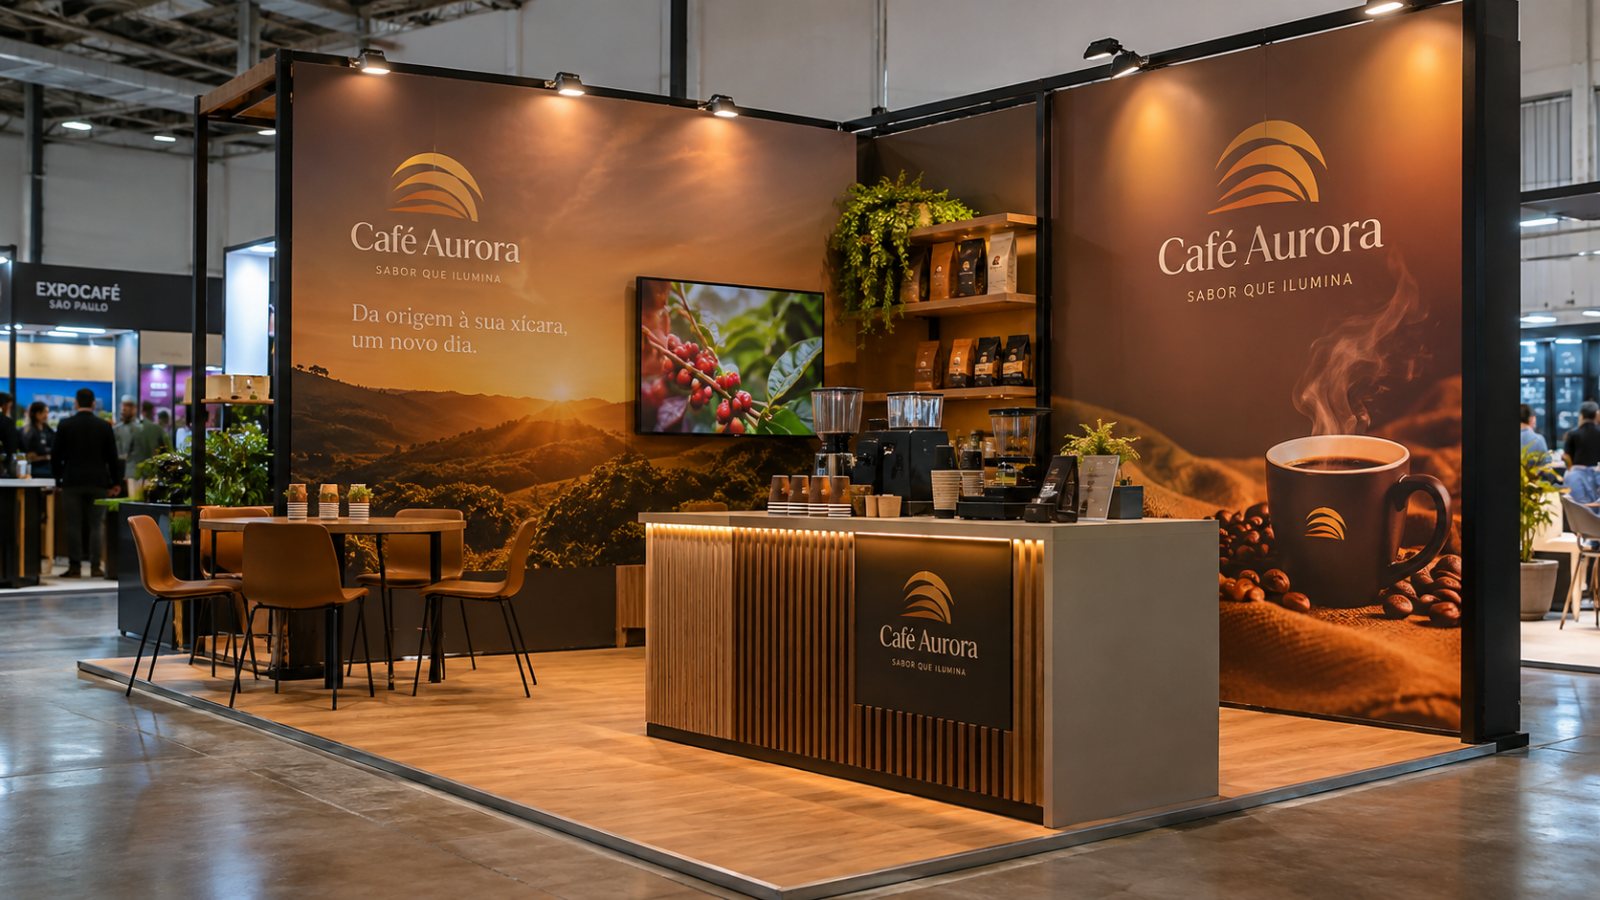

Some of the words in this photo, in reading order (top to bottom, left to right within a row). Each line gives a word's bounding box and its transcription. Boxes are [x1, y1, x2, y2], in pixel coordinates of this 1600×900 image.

[350, 221, 417, 255] Café
[423, 228, 520, 263] Aurora
[1158, 229, 1237, 276] Café
[1244, 217, 1384, 266] Aurora
[375, 265, 417, 277] SABOR
[422, 269, 447, 280] QUE
[452, 271, 501, 283] ILUMINA
[36, 281, 120, 301] EXPOCAFÉ
[1187, 286, 1237, 303] SABOR
[1244, 281, 1275, 298] QUE
[1283, 272, 1353, 292] ILUMINA
[74, 301, 109, 312] PAULO
[352, 303, 380, 323] Da
[385, 306, 453, 331] origem
[459, 310, 469, 329] à
[475, 315, 505, 331] sua
[511, 314, 568, 337] xícara,
[352, 334, 383, 350] um
[390, 336, 438, 352] novo
[443, 334, 477, 354] dia.
[880, 624, 915, 649] Café
[919, 629, 978, 658] Aurora
[891, 658, 916, 669] SABOR
[917, 663, 933, 672] QUE
[934, 665, 966, 676] ILUMINA
